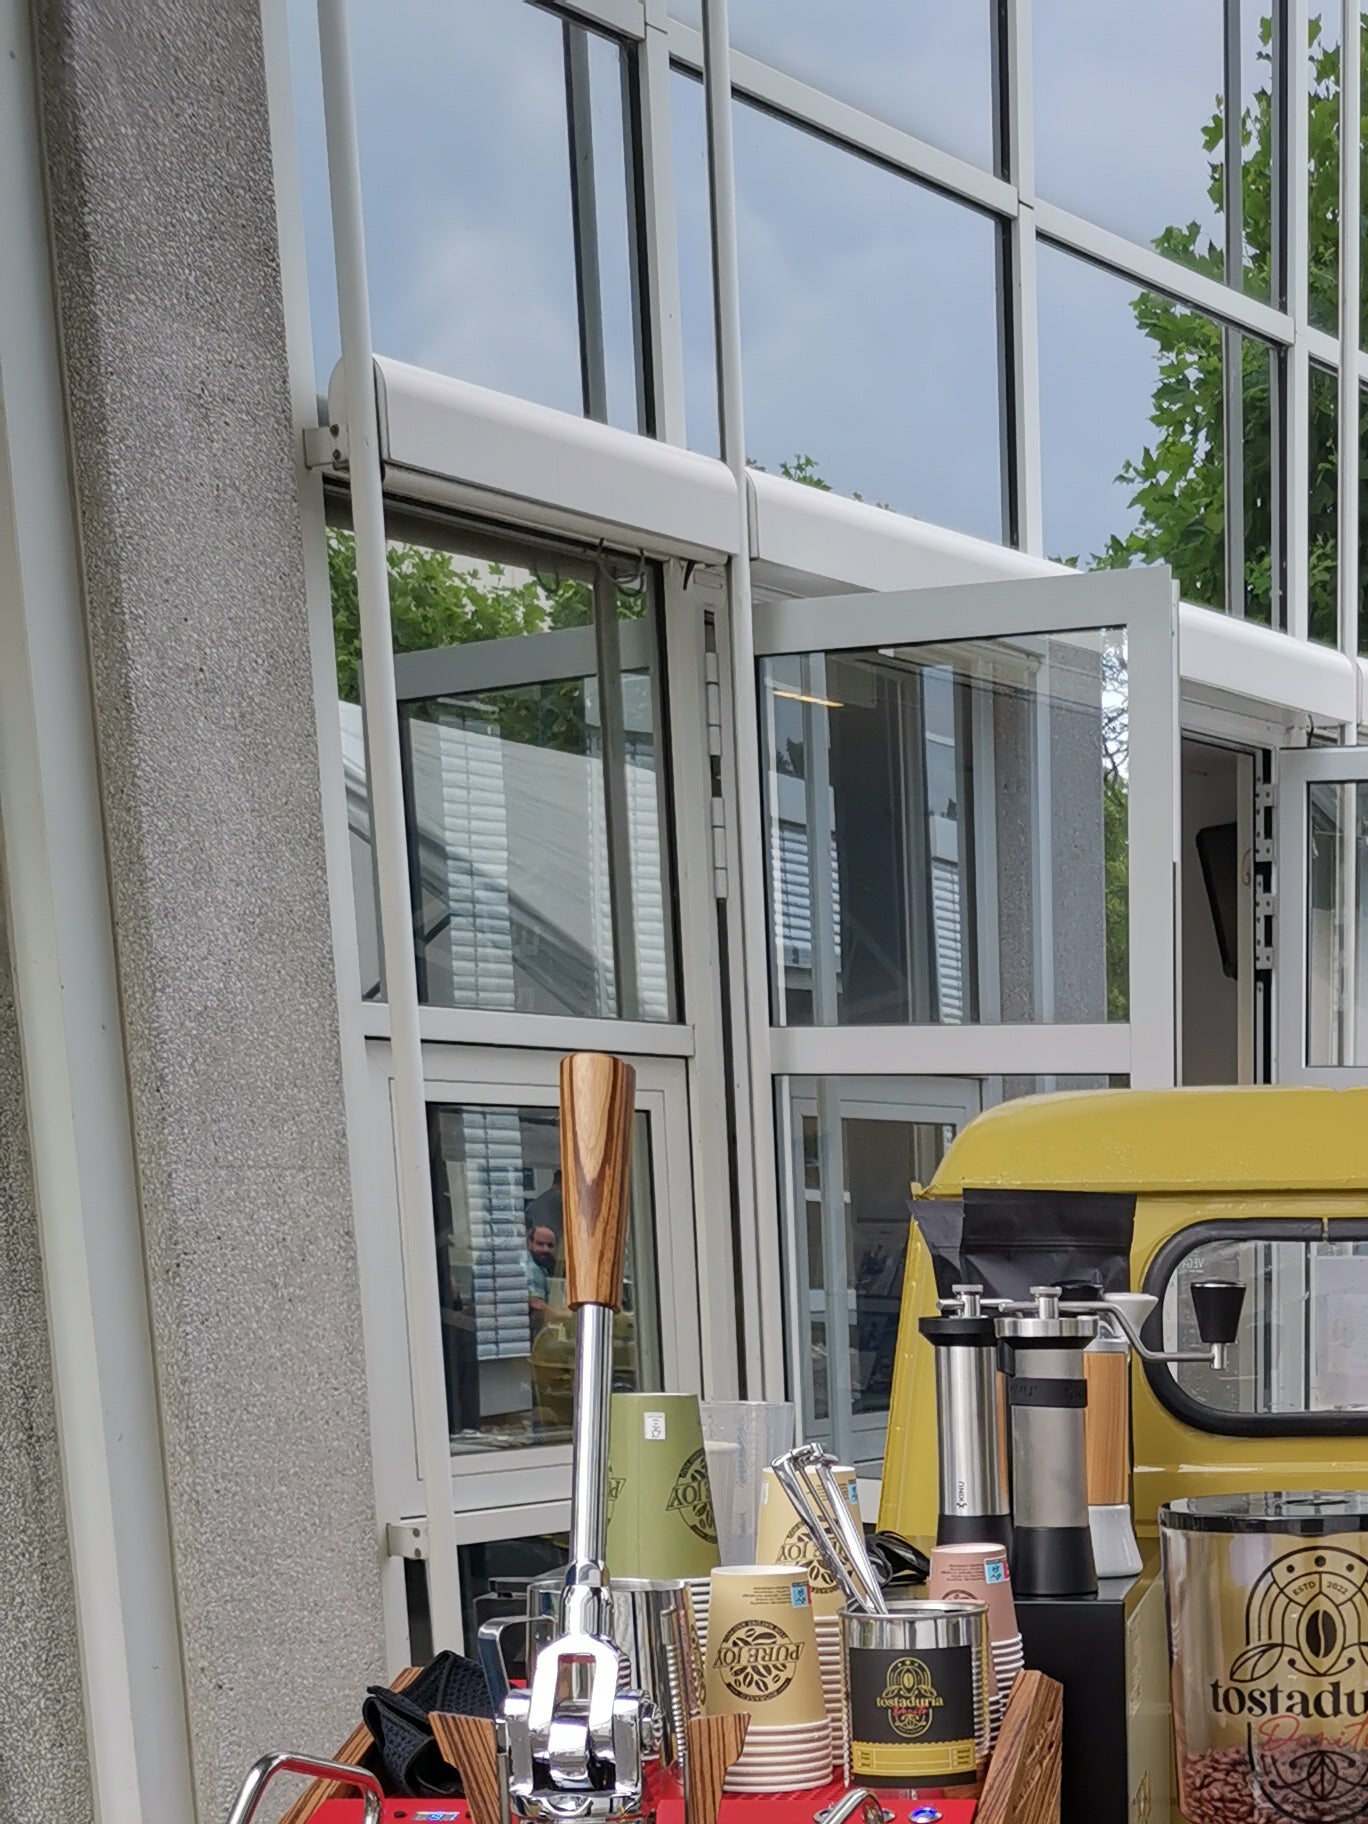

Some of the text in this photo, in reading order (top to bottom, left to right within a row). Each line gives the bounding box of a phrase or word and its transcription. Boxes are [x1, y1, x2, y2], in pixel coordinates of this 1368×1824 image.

[670, 1482, 702, 1507] JOY
[778, 1542, 808, 1562] JOY
[1292, 1581, 1349, 1596] ESTD 2022
[713, 1644, 801, 1668] PURE JOY
